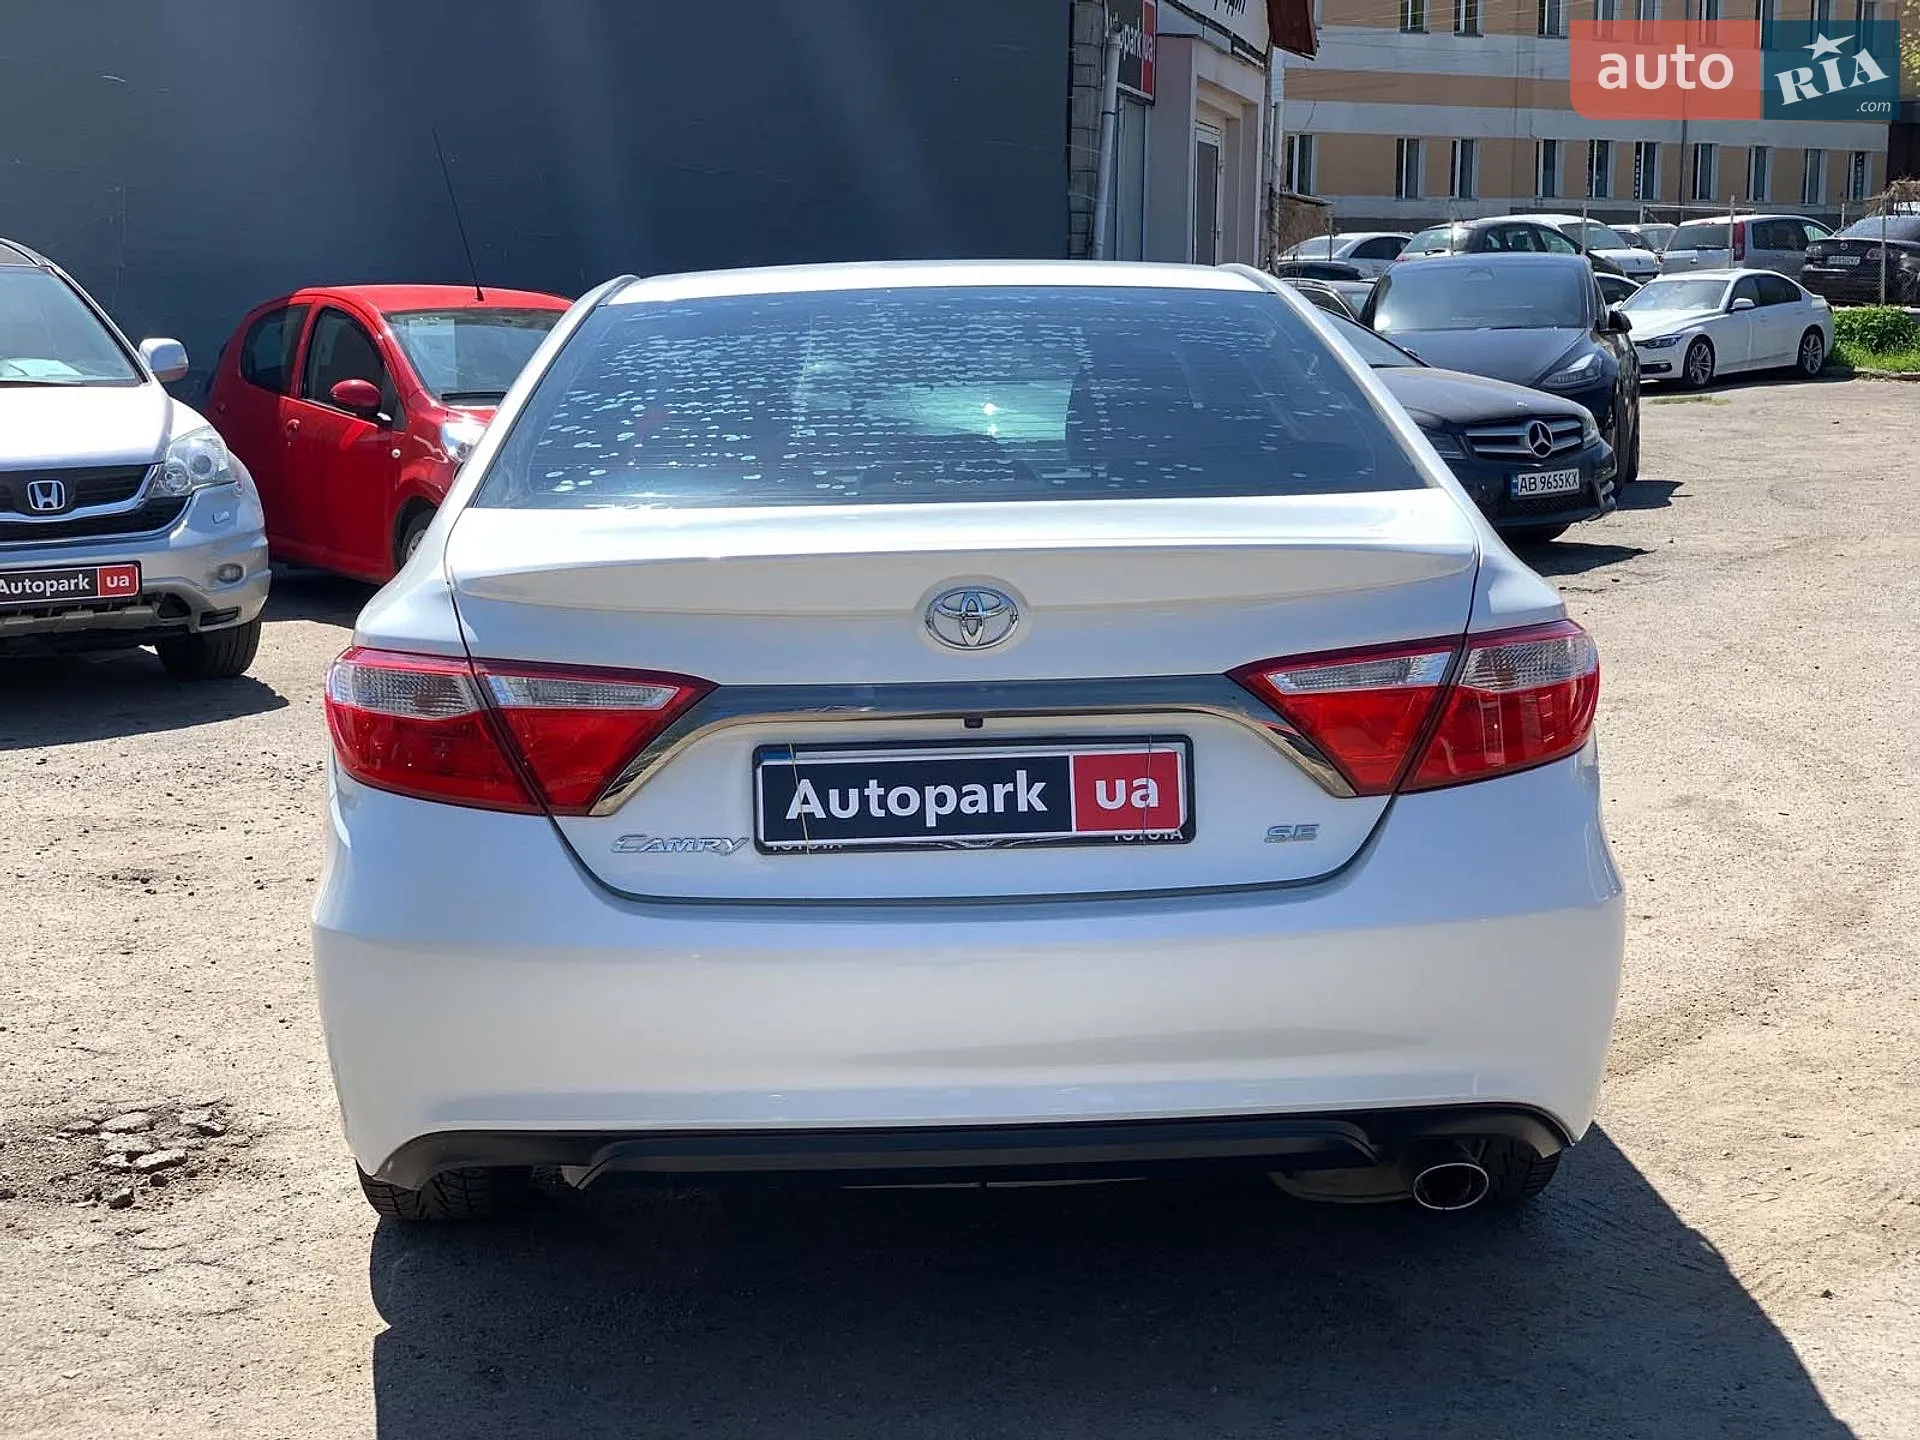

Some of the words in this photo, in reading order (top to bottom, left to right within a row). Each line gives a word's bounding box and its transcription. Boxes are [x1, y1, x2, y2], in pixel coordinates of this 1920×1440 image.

[1519, 477, 1537, 493] AB
[0, 573, 91, 597] Autopark
[105, 574, 130, 588] ua
[785, 769, 1048, 828] Autopark
[1095, 776, 1160, 810] ua
[1264, 823, 1321, 844] SE
[611, 834, 750, 856] CAMRY
